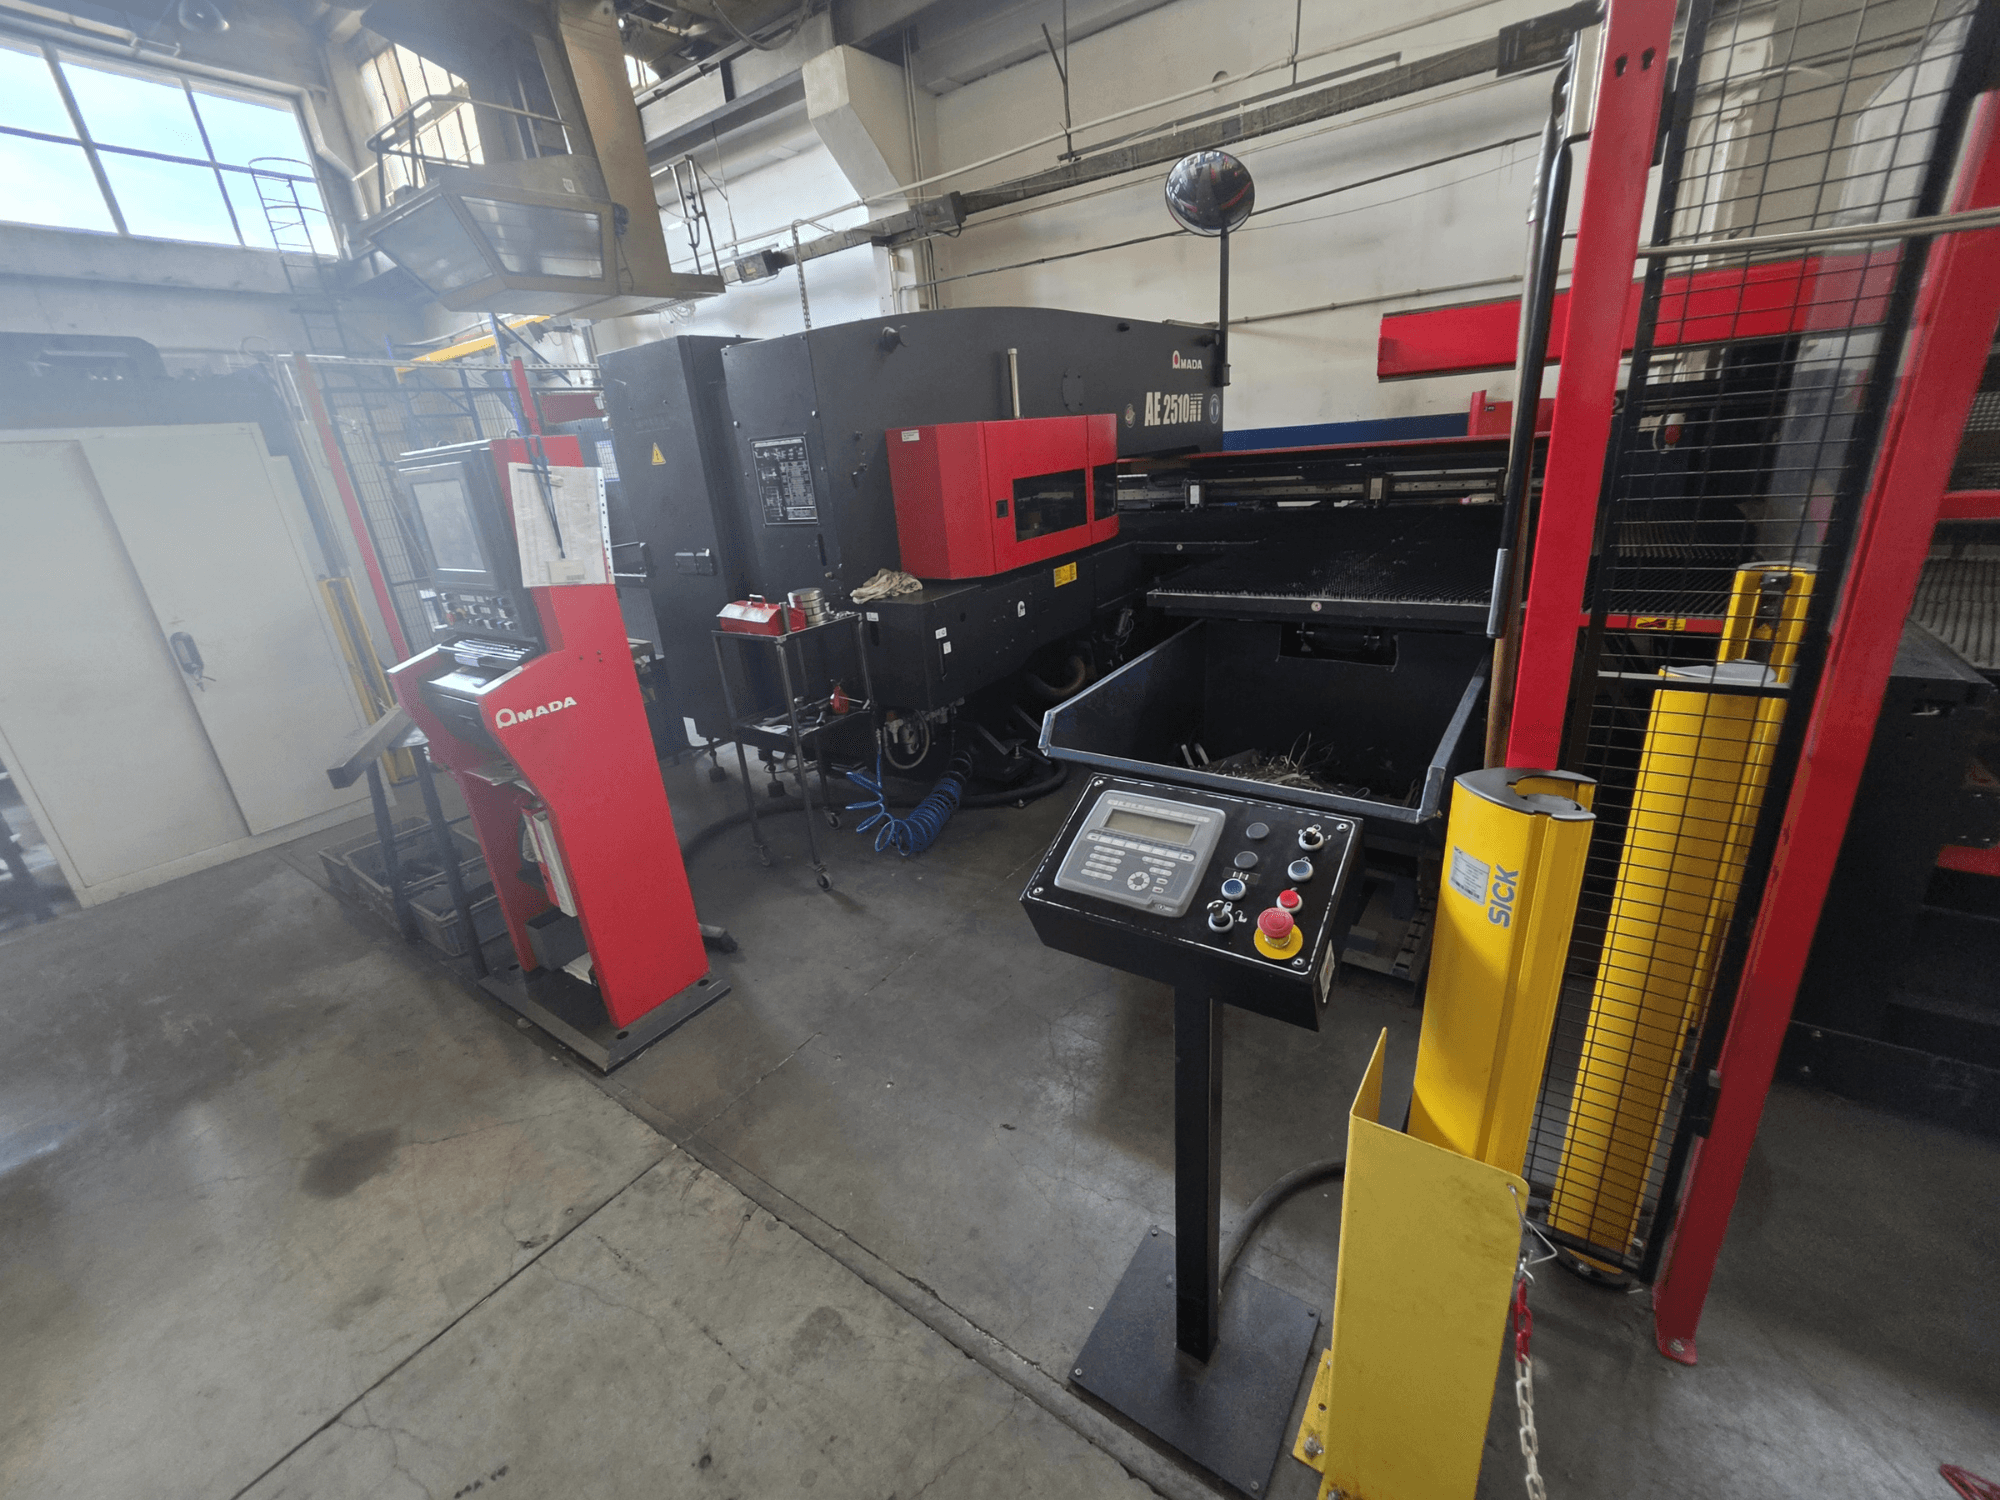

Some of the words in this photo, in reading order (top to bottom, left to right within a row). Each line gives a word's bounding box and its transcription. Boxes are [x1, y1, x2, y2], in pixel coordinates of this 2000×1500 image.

[1144, 391, 1161, 426] AE
[495, 696, 578, 730] AMADA
[1488, 864, 1518, 928] SICK
